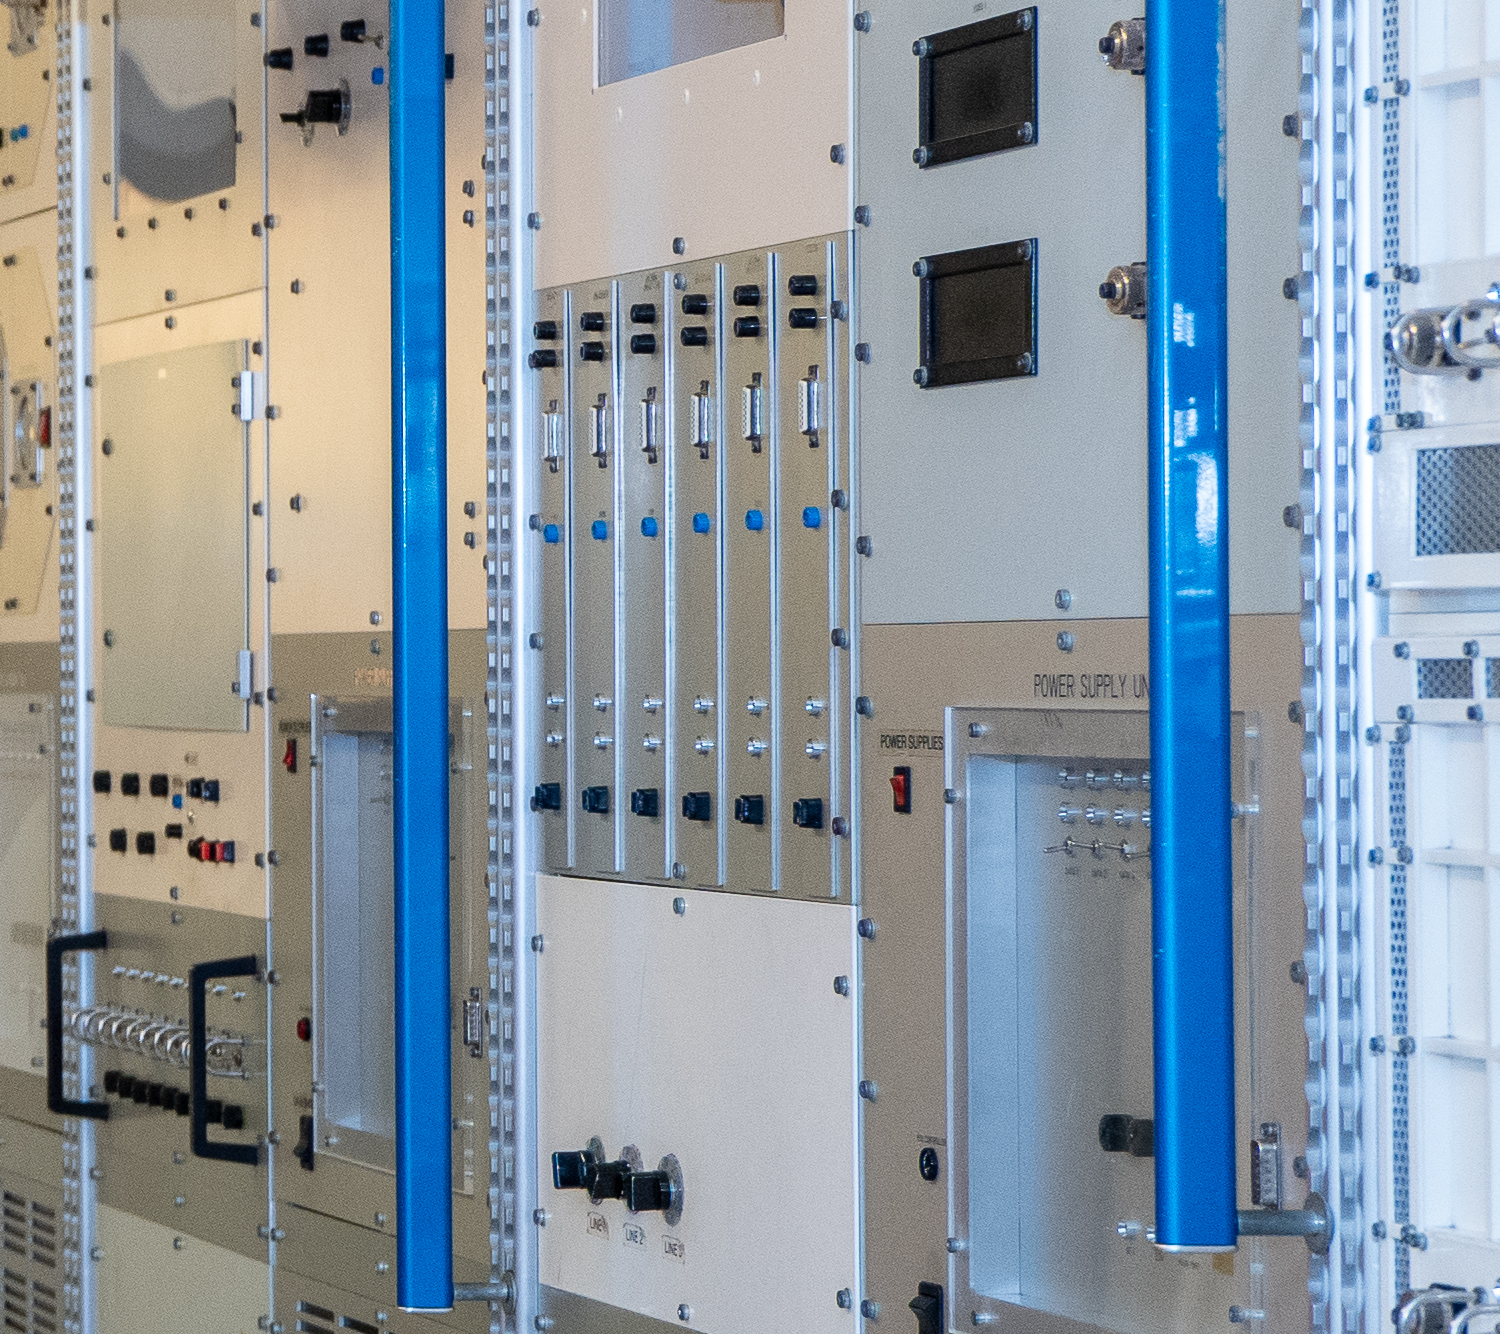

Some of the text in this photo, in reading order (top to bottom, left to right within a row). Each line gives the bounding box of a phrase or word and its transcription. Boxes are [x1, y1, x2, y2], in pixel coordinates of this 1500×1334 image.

[1034, 673, 1075, 699] POWER
[1080, 673, 1128, 699] SUPPLY
[880, 733, 944, 751] POWER SUPPLIES
